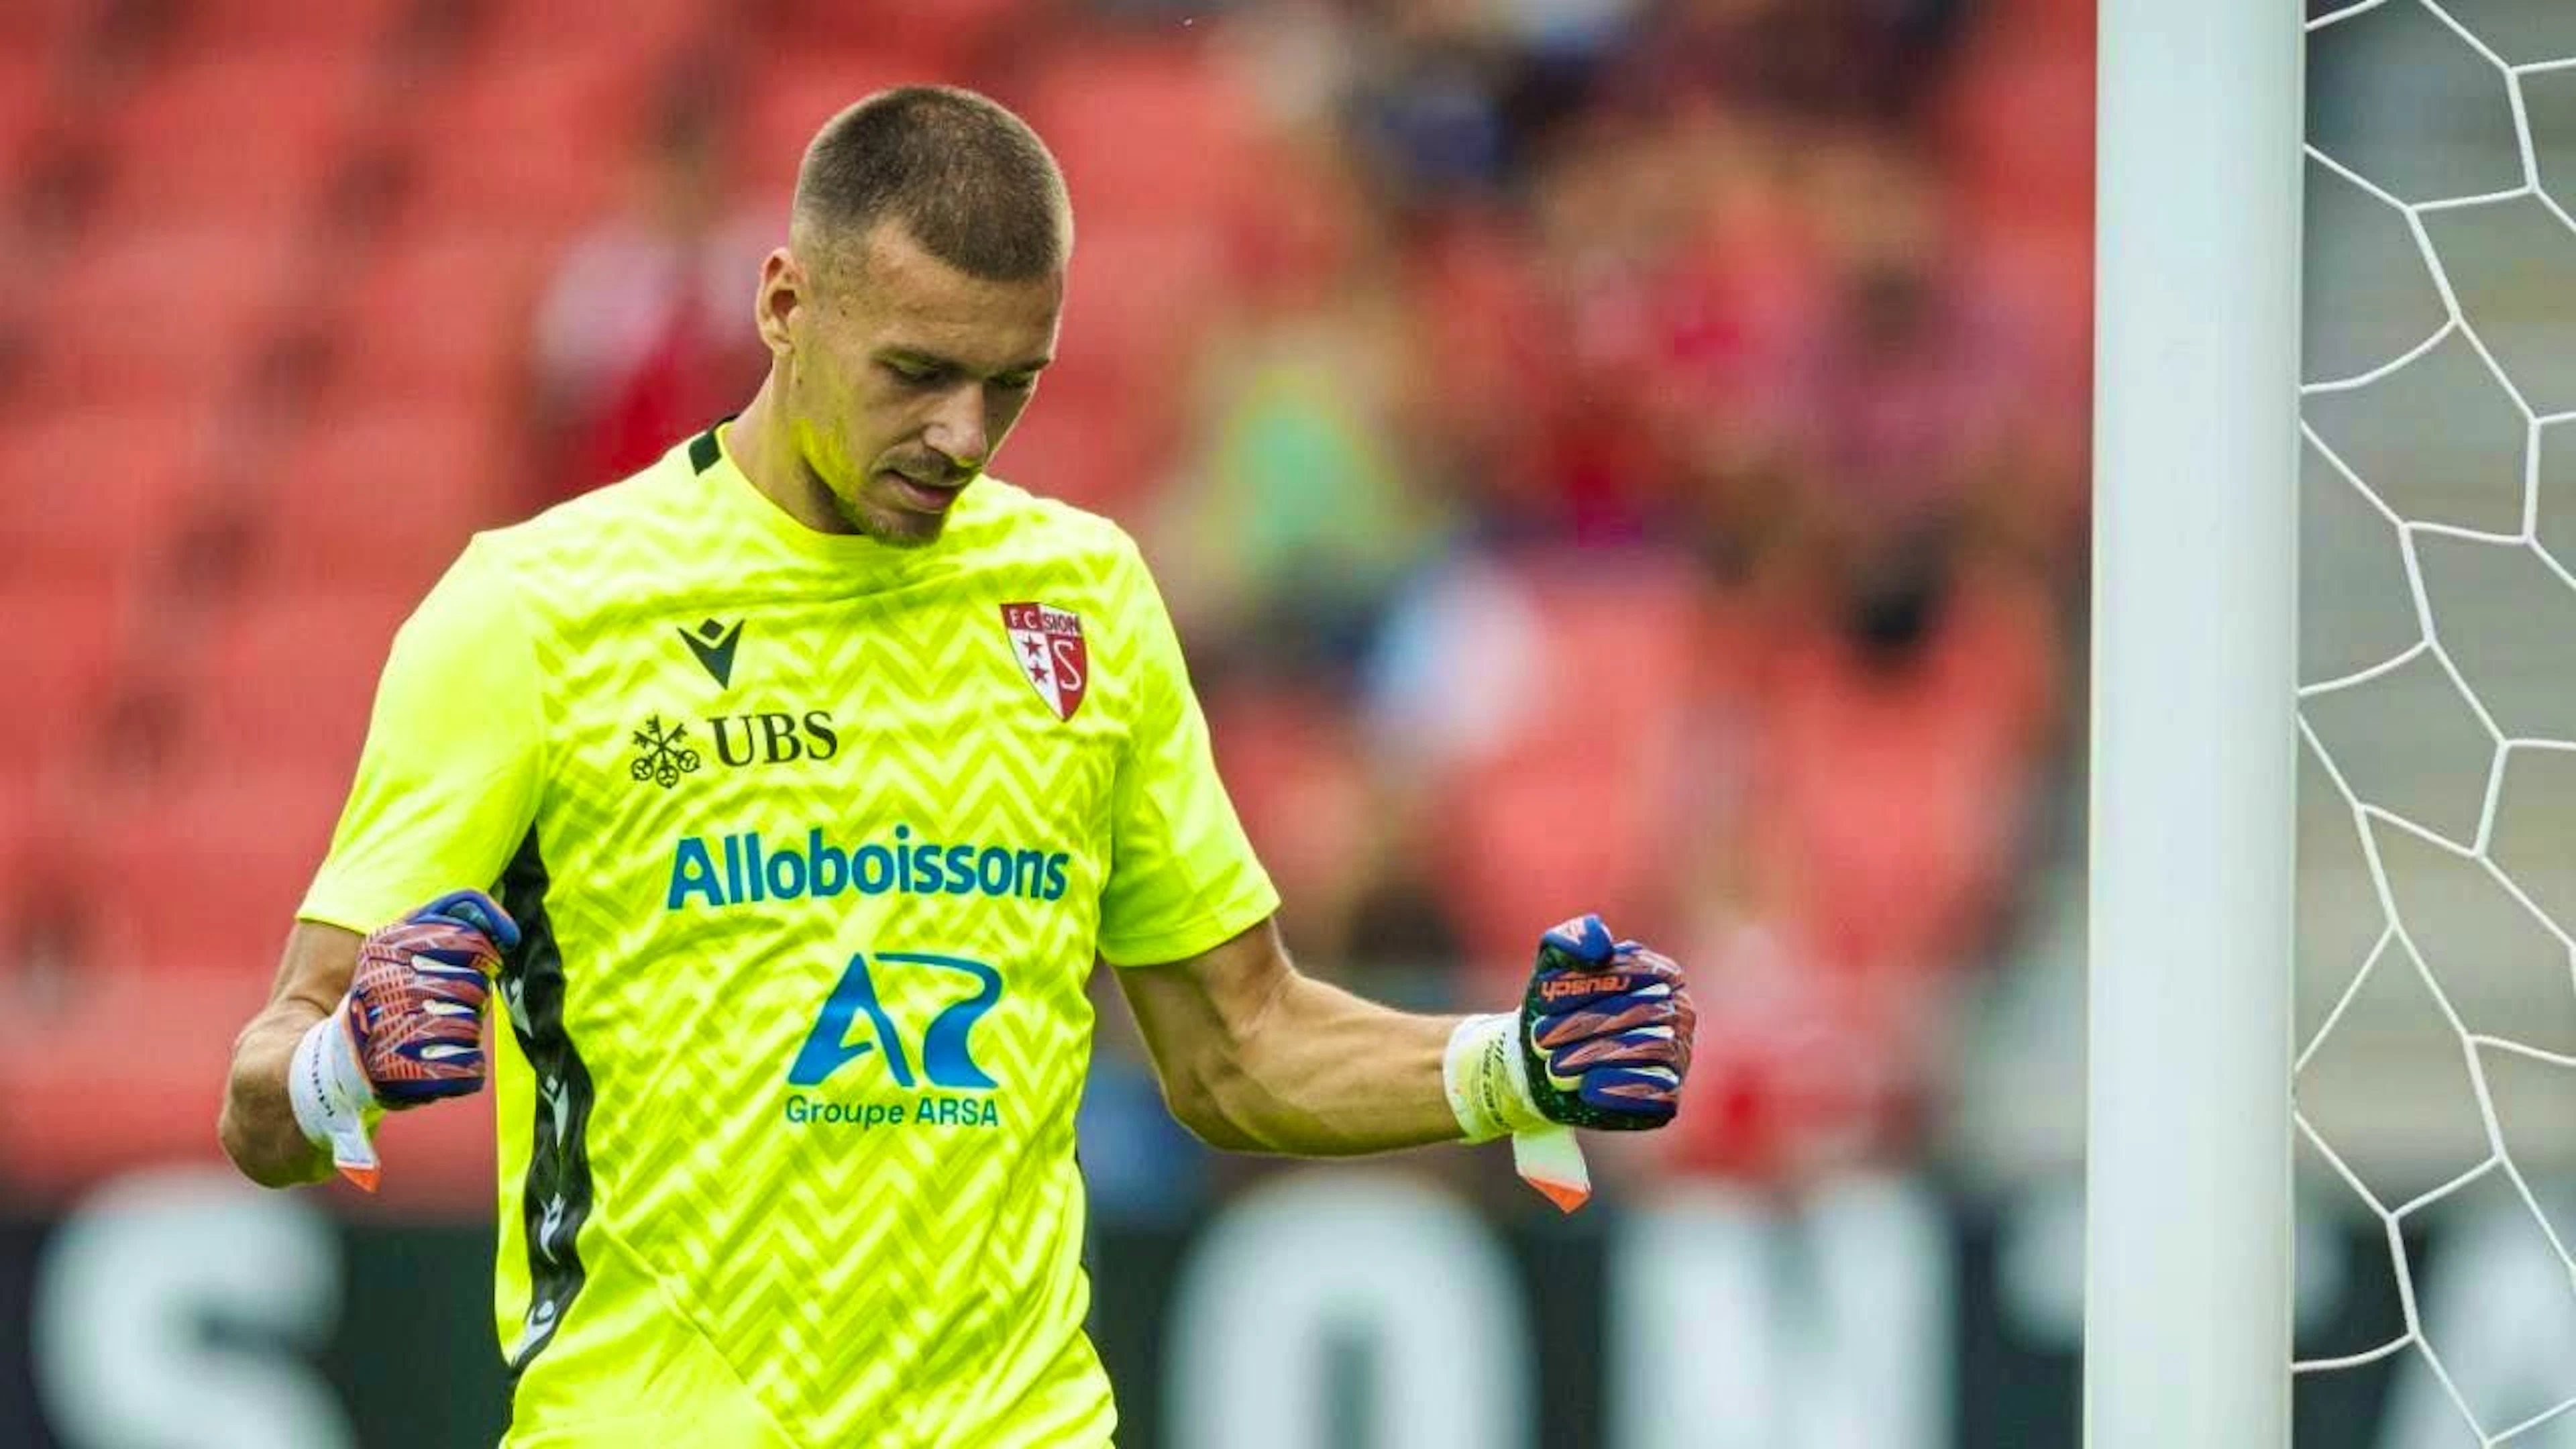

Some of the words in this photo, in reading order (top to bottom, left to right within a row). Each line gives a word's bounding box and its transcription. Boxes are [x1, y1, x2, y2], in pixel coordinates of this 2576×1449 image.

[1053, 641, 1081, 690] S
[707, 710, 839, 767] UBS
[667, 824, 1069, 910] Alloboissons
[1541, 974, 1630, 1000] reusch
[786, 1095, 904, 1129] Groupe
[915, 1098, 1000, 1127] ARSA
